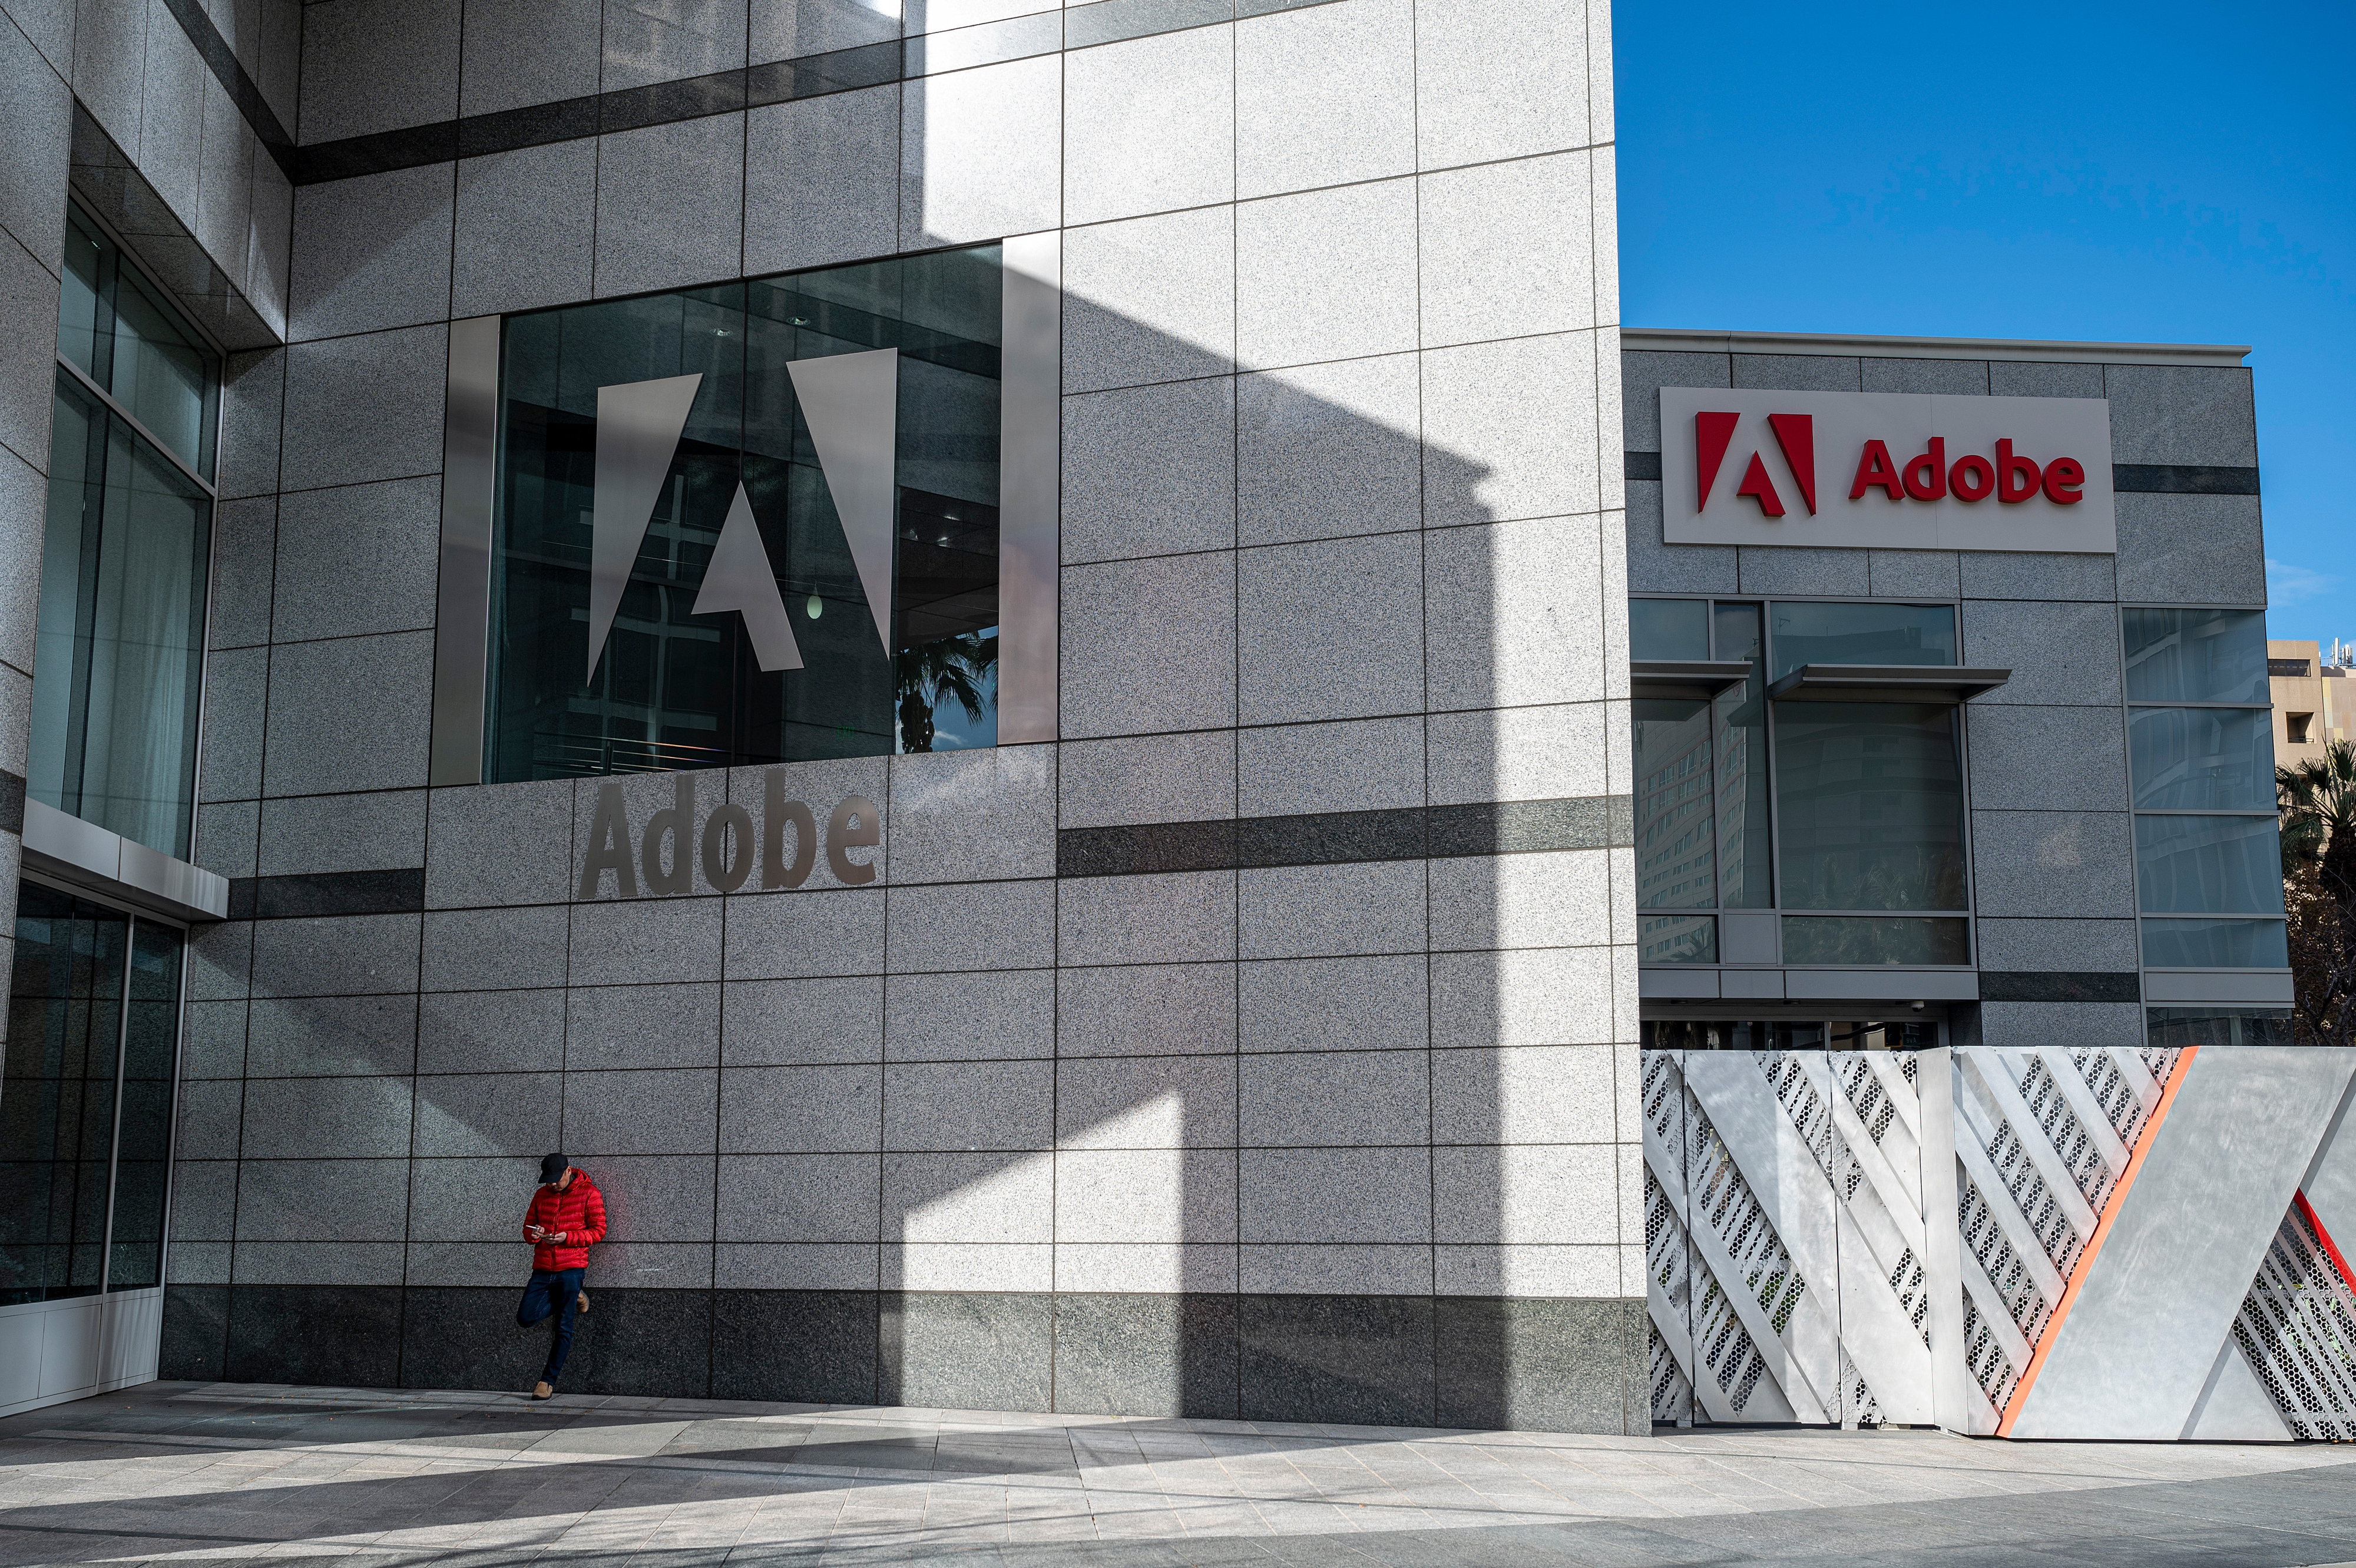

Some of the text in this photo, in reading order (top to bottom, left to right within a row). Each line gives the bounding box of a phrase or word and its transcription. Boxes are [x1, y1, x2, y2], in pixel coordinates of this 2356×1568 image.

[1848, 436, 2086, 505] Adobe
[837, 726, 855, 739] EXIT
[578, 768, 880, 899] Adobe
